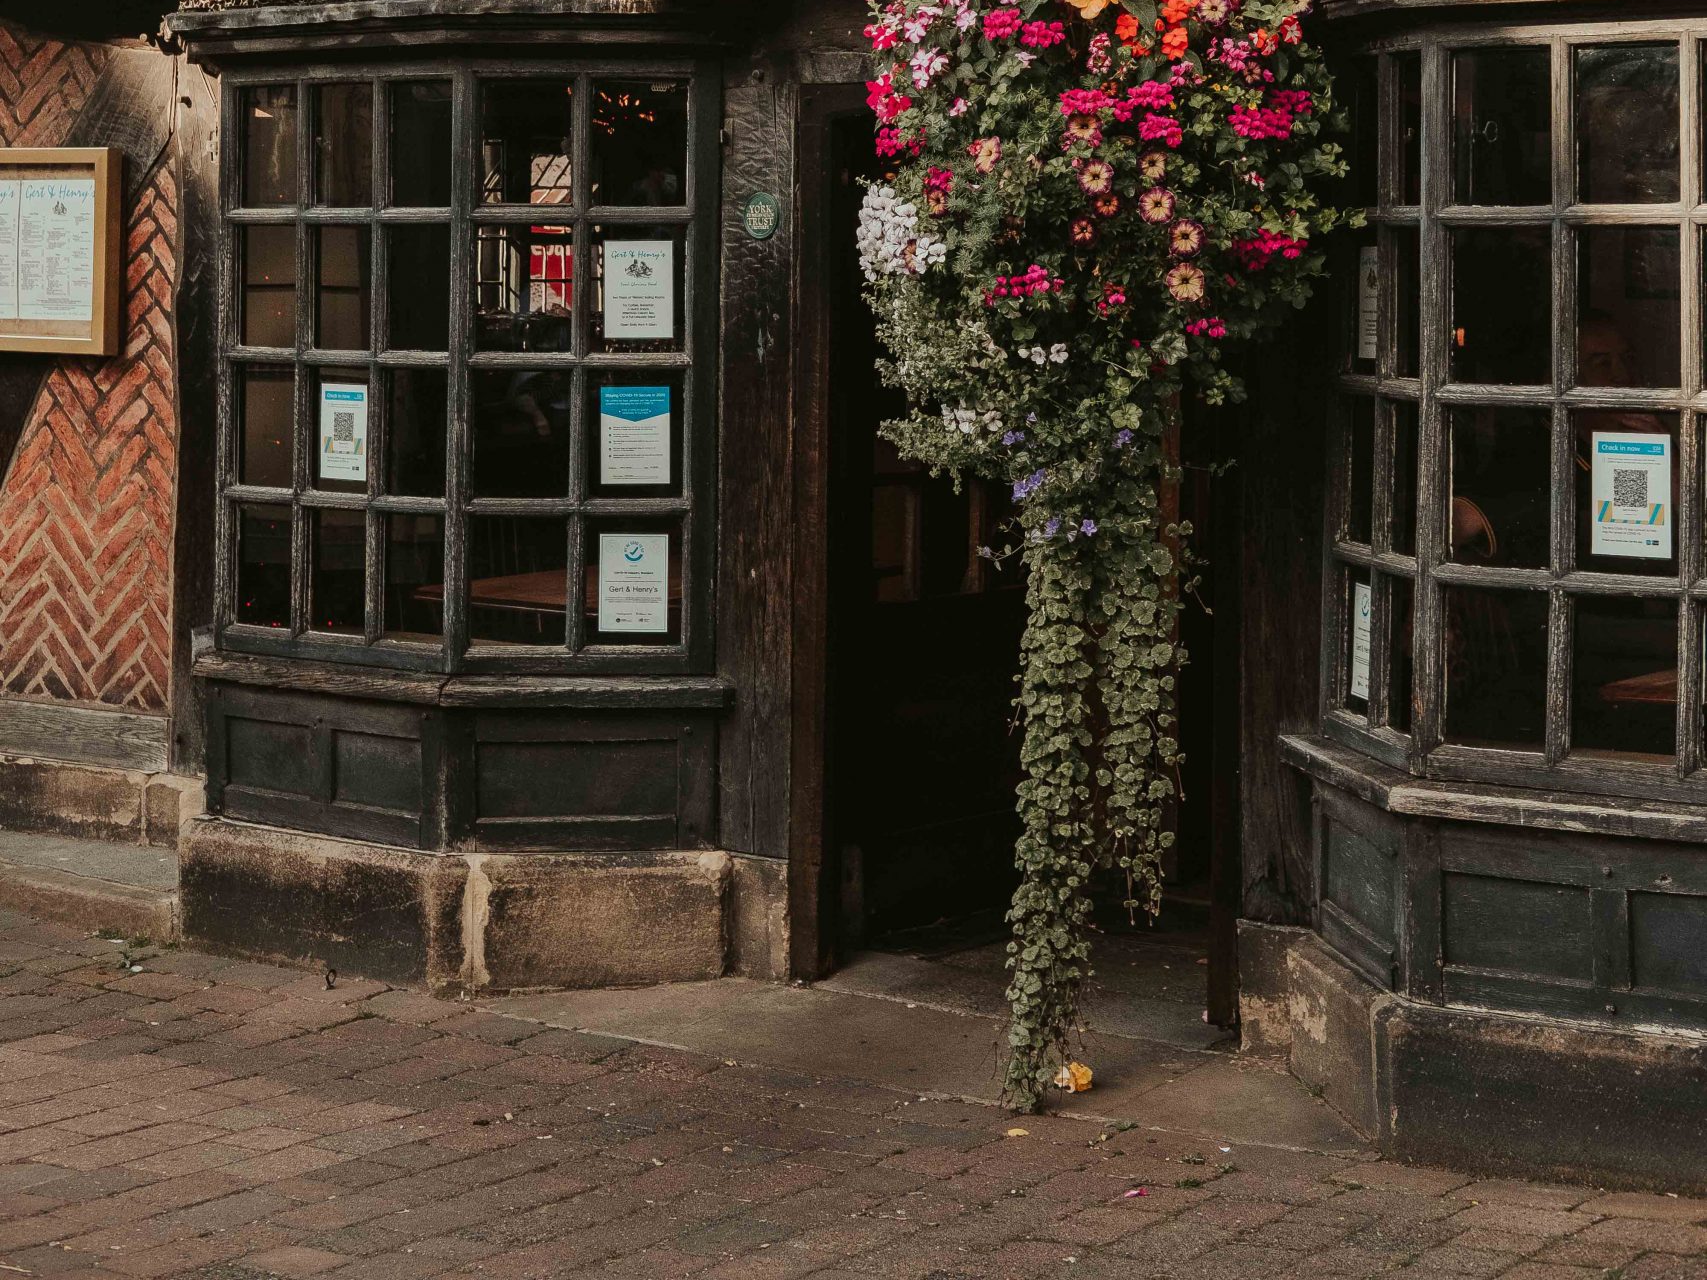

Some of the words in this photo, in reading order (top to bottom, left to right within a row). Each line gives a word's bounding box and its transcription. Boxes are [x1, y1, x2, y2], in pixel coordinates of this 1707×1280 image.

[26, 185, 45, 200] Gert
[749, 204, 772, 213] YORK
[747, 218, 774, 226] TRUST
[1601, 443, 1618, 451] Check
[609, 585, 624, 593] Gert
[625, 585, 631, 593] &
[633, 585, 658, 594] Henry's
